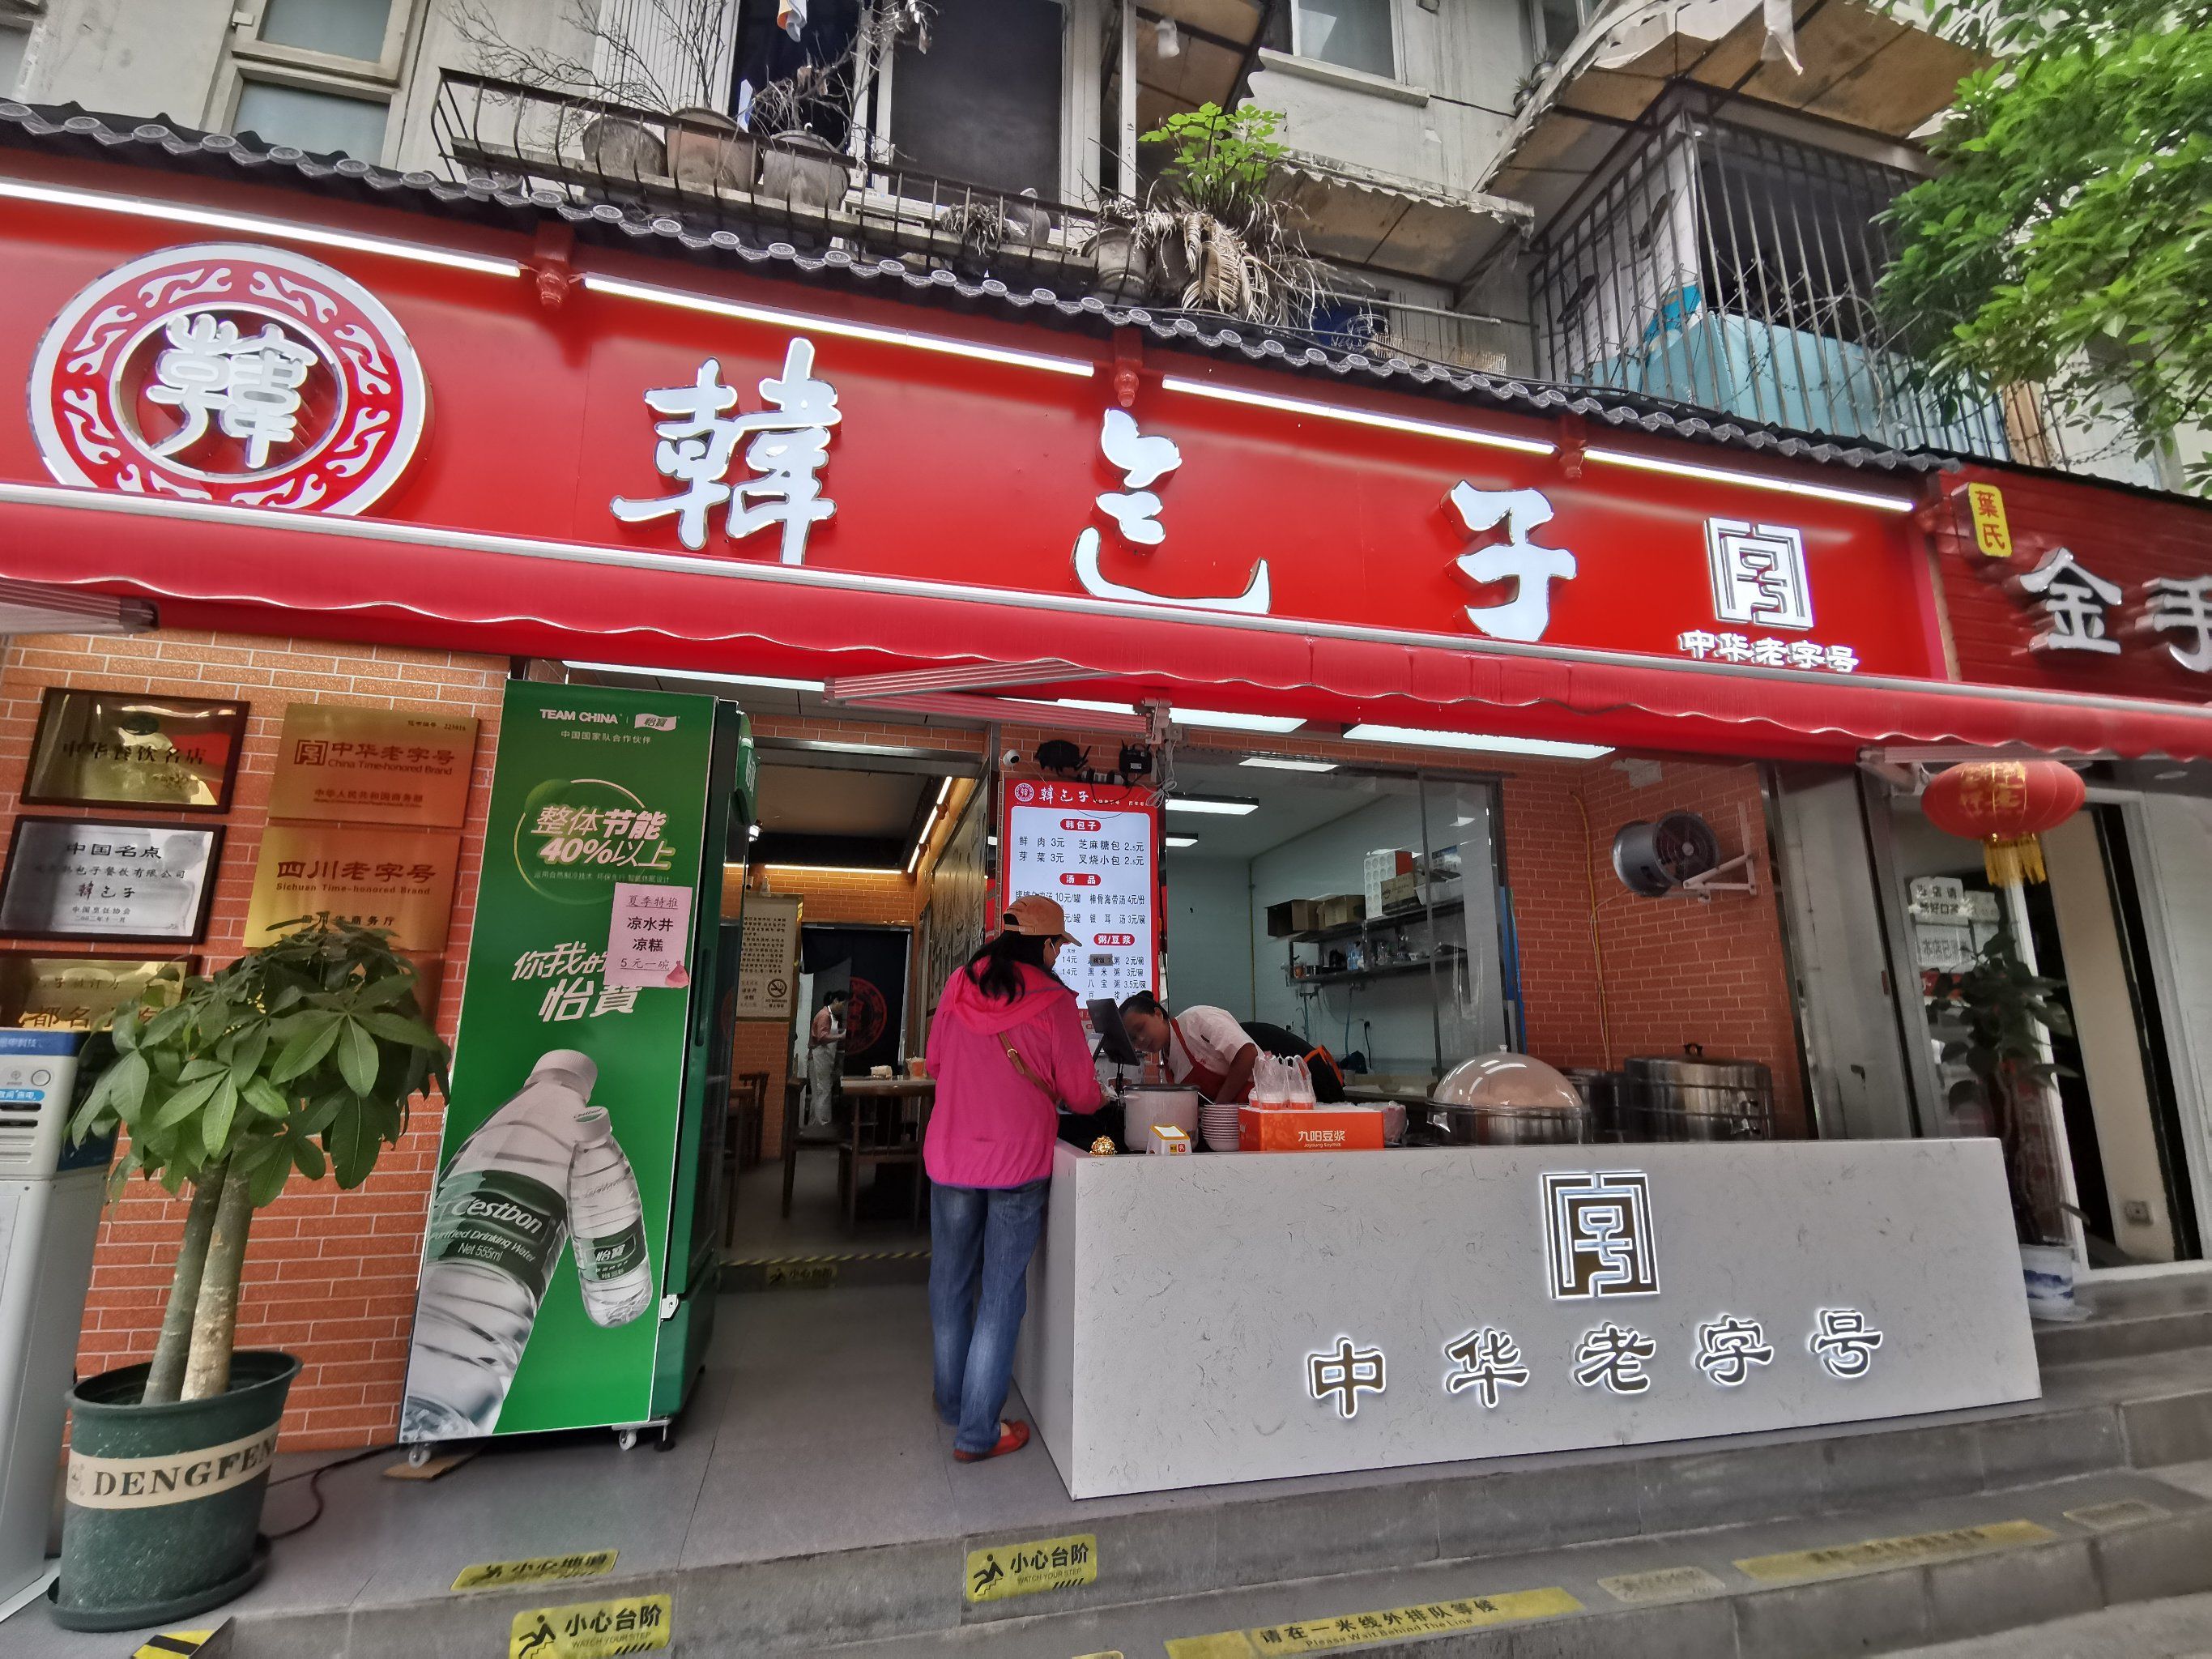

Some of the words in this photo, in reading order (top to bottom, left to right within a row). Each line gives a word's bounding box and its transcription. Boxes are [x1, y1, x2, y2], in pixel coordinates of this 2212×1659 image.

[1975, 489, 2005, 550] 葉氏
[2019, 547, 2212, 673] 金手
[1677, 629, 1859, 672] 中华老字号
[539, 709, 576, 721] TEAM
[578, 711, 618, 724] CHINA
[560, 730, 651, 744] 中国国家队合作伙伴
[331, 742, 454, 765] 中华老字号
[328, 758, 356, 769] China
[359, 760, 422, 774] Time-honored
[424, 764, 452, 775] Brand
[531, 806, 667, 840] 整体节能
[1065, 820, 1097, 830] 韩包子
[1051, 837, 1065, 848] 3元
[1078, 838, 1120, 851] 芝麻糖包
[1124, 842, 1144, 851] 2.5元
[67, 842, 162, 859] 中国名点
[539, 838, 673, 867] 40%以上
[1051, 852, 1064, 864] 3元
[1078, 854, 1120, 866] 叉烧小包
[1124, 855, 1144, 866] 2.5元
[276, 860, 437, 883] 四川老字号
[1066, 875, 1096, 885] 汤品
[276, 882, 316, 891] Sichuan
[323, 884, 395, 893] Time-honored
[400, 886, 430, 895] Brand
[628, 895, 679, 907] 夏季特推
[1089, 894, 1126, 905] 棒骨海带汤
[627, 916, 673, 932] 凉水井
[1089, 914, 1126, 924] 银耳汤
[633, 937, 663, 952] 凉糕
[1097, 935, 1131, 945] 粥/豆浆
[1062, 956, 1077, 964] 14元
[1062, 968, 1077, 976] 14元
[1088, 967, 1120, 976] 黑米粥
[1088, 979, 1120, 988] 八宝粥
[1298, 1130, 1345, 1141] 九阳豆浆
[458, 1242, 475, 1255] Net
[475, 1244, 504, 1261] 555ml
[470, 1230, 512, 1248] Drinking
[511, 1242, 535, 1262] Water
[1306, 1307, 1883, 1418] 中华老字号
[1010, 1542, 1089, 1573] 小心台阶
[1017, 1575, 1042, 1585] WATCH
[1042, 1571, 1063, 1580] YOUR
[1063, 1567, 1081, 1577] STEP
[565, 1604, 662, 1637] 小心台阶
[1259, 1597, 1498, 1644] 请在一米线外排队等候
[571, 1638, 604, 1649] WATCH
[604, 1635, 628, 1645] YOUR
[628, 1631, 651, 1642] STEP
[1306, 1635, 1346, 1648] Please
[1348, 1631, 1378, 1642] Wait
[1380, 1624, 1421, 1637] Behind
[1423, 1620, 1445, 1631] The
[1446, 1618, 1473, 1628] Line
